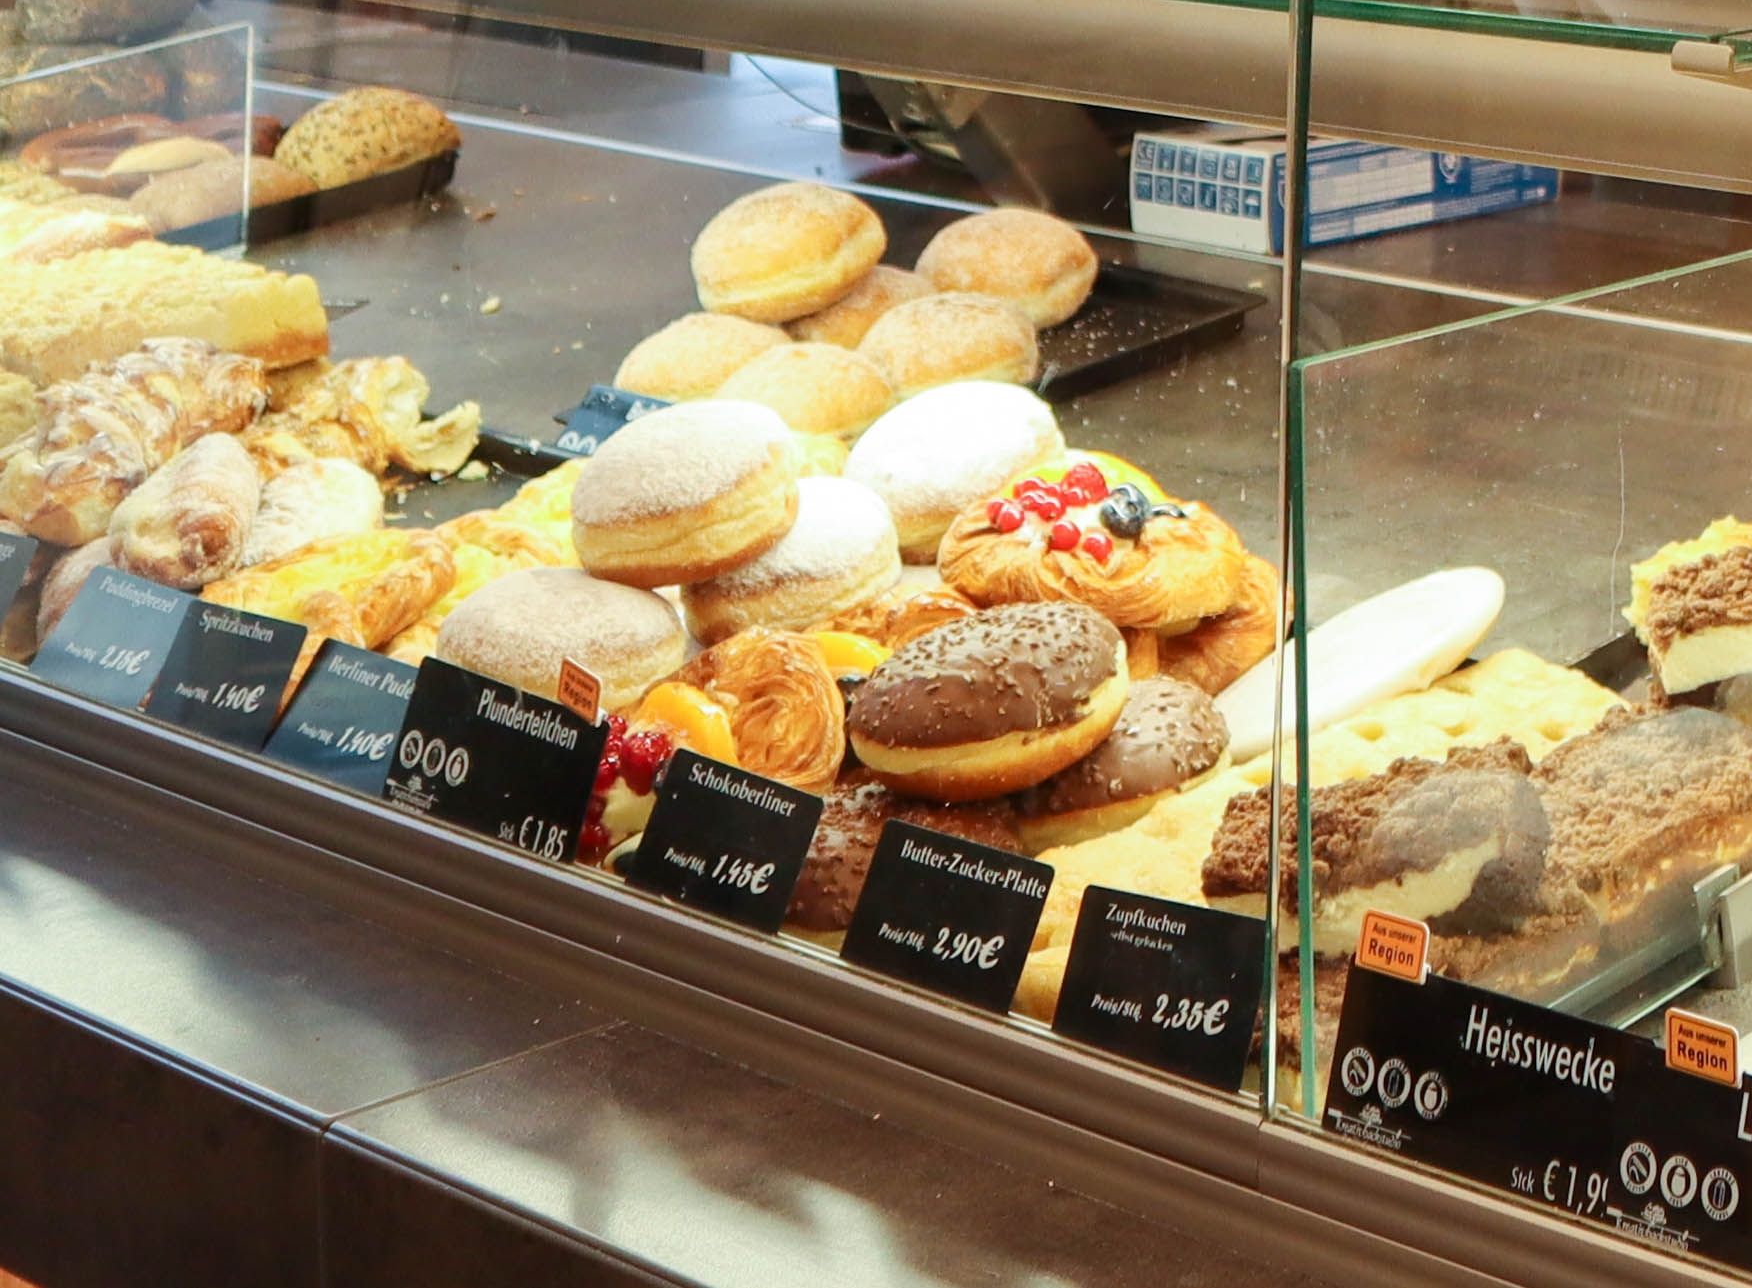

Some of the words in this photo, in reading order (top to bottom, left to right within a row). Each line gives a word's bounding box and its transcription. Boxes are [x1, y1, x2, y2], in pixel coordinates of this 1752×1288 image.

[200, 609, 275, 644] Spritzkuchen
[328, 654, 382, 690] Berliner
[212, 683, 266, 714] 1,40€
[476, 687, 579, 751] Plunderteilchen
[335, 726, 394, 762] 1,40€
[688, 763, 797, 818] Schokoberliner
[519, 815, 534, 849] €
[711, 853, 775, 896] 1,45€
[900, 838, 1048, 901] Butter-Zucker-Platte
[1105, 903, 1187, 936] Zupfkuchen
[1372, 922, 1387, 936] Aus
[1388, 926, 1417, 944] unserer
[931, 926, 1005, 971] 2,90€
[1368, 939, 1415, 967] Region
[1151, 993, 1230, 1036] 2,35€
[1464, 1002, 1617, 1095] Heisswecke
[1677, 1023, 1693, 1038] Aus
[1694, 1029, 1727, 1048] unserer
[1677, 1040, 1729, 1072] Region
[1543, 1159, 1562, 1202] €
